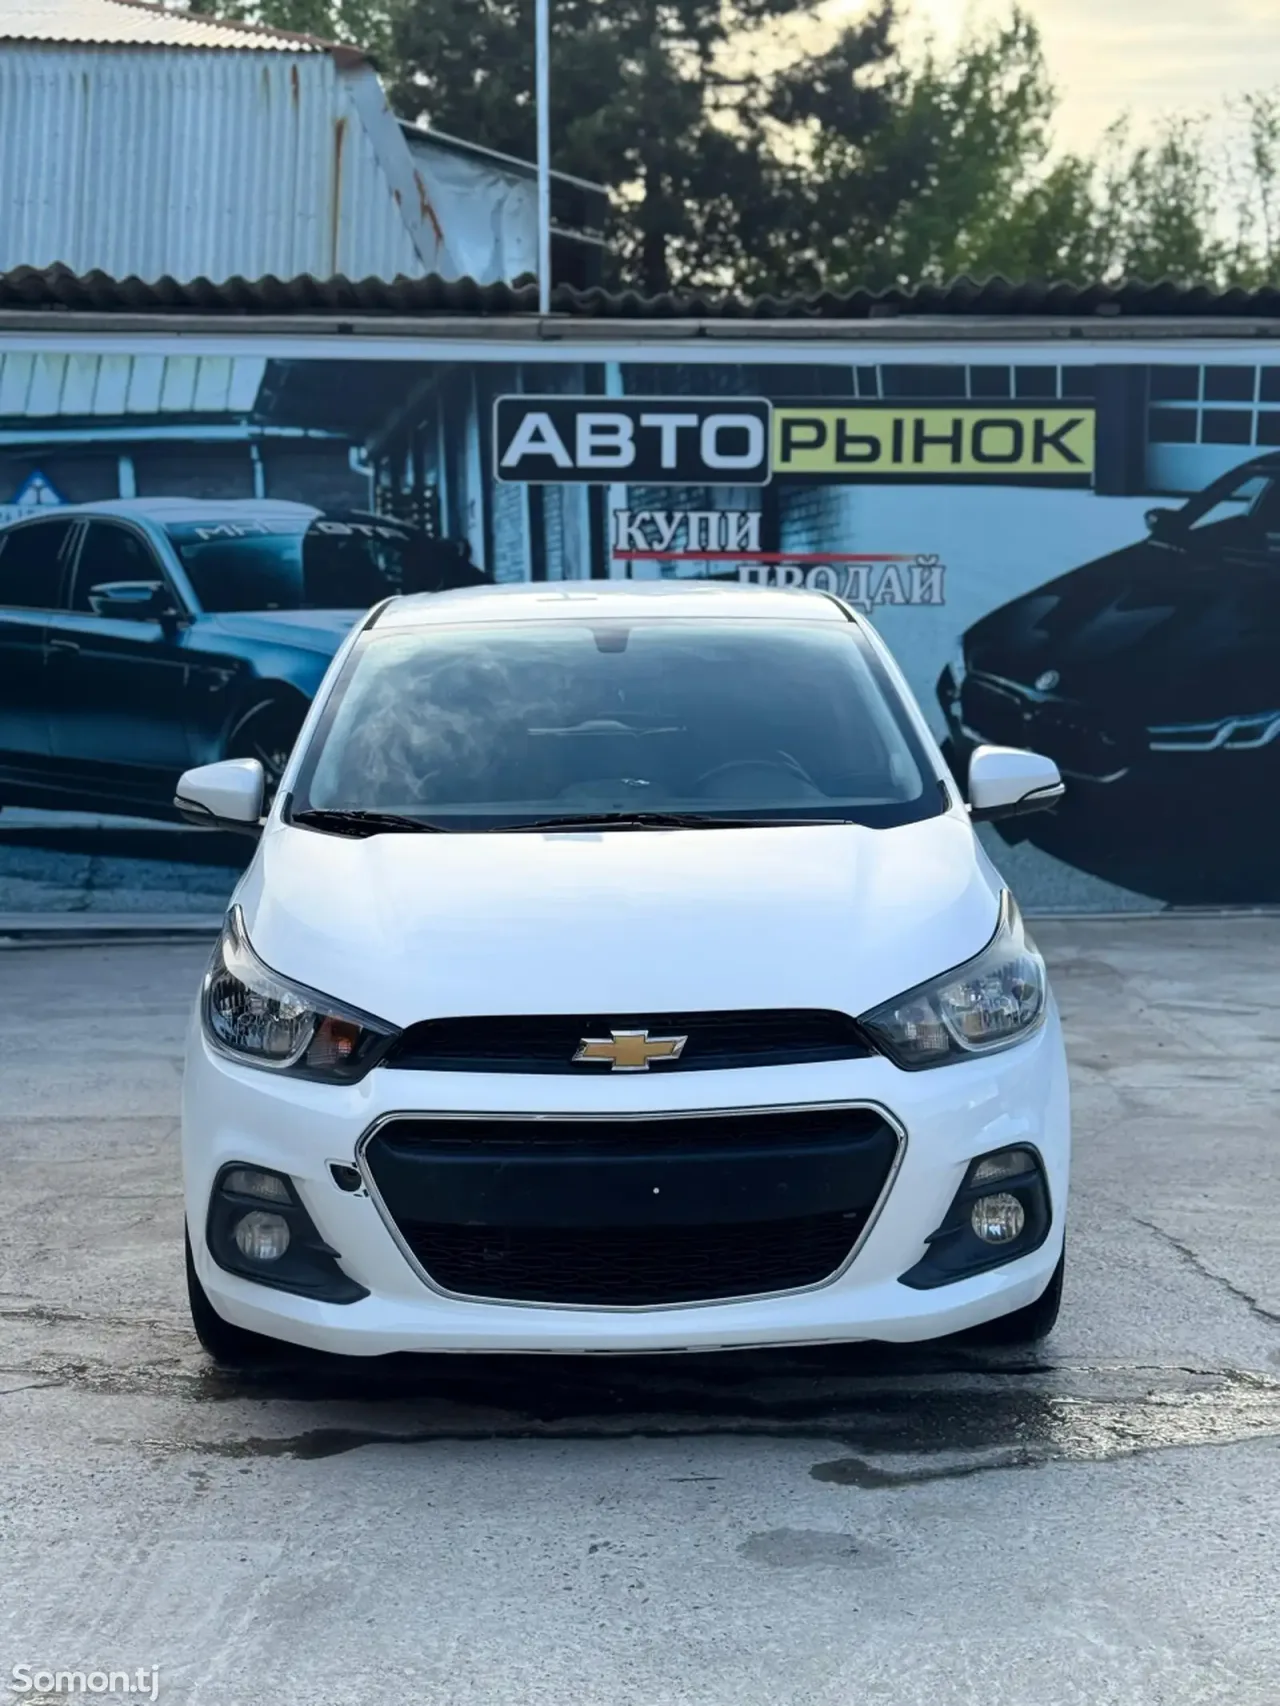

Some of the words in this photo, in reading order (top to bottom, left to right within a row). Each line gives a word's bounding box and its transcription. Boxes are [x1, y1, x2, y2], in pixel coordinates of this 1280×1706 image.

[500, 412, 764, 469] АВТО
[780, 417, 1086, 464] РЫНОК
[614, 509, 762, 553] КУПИ
